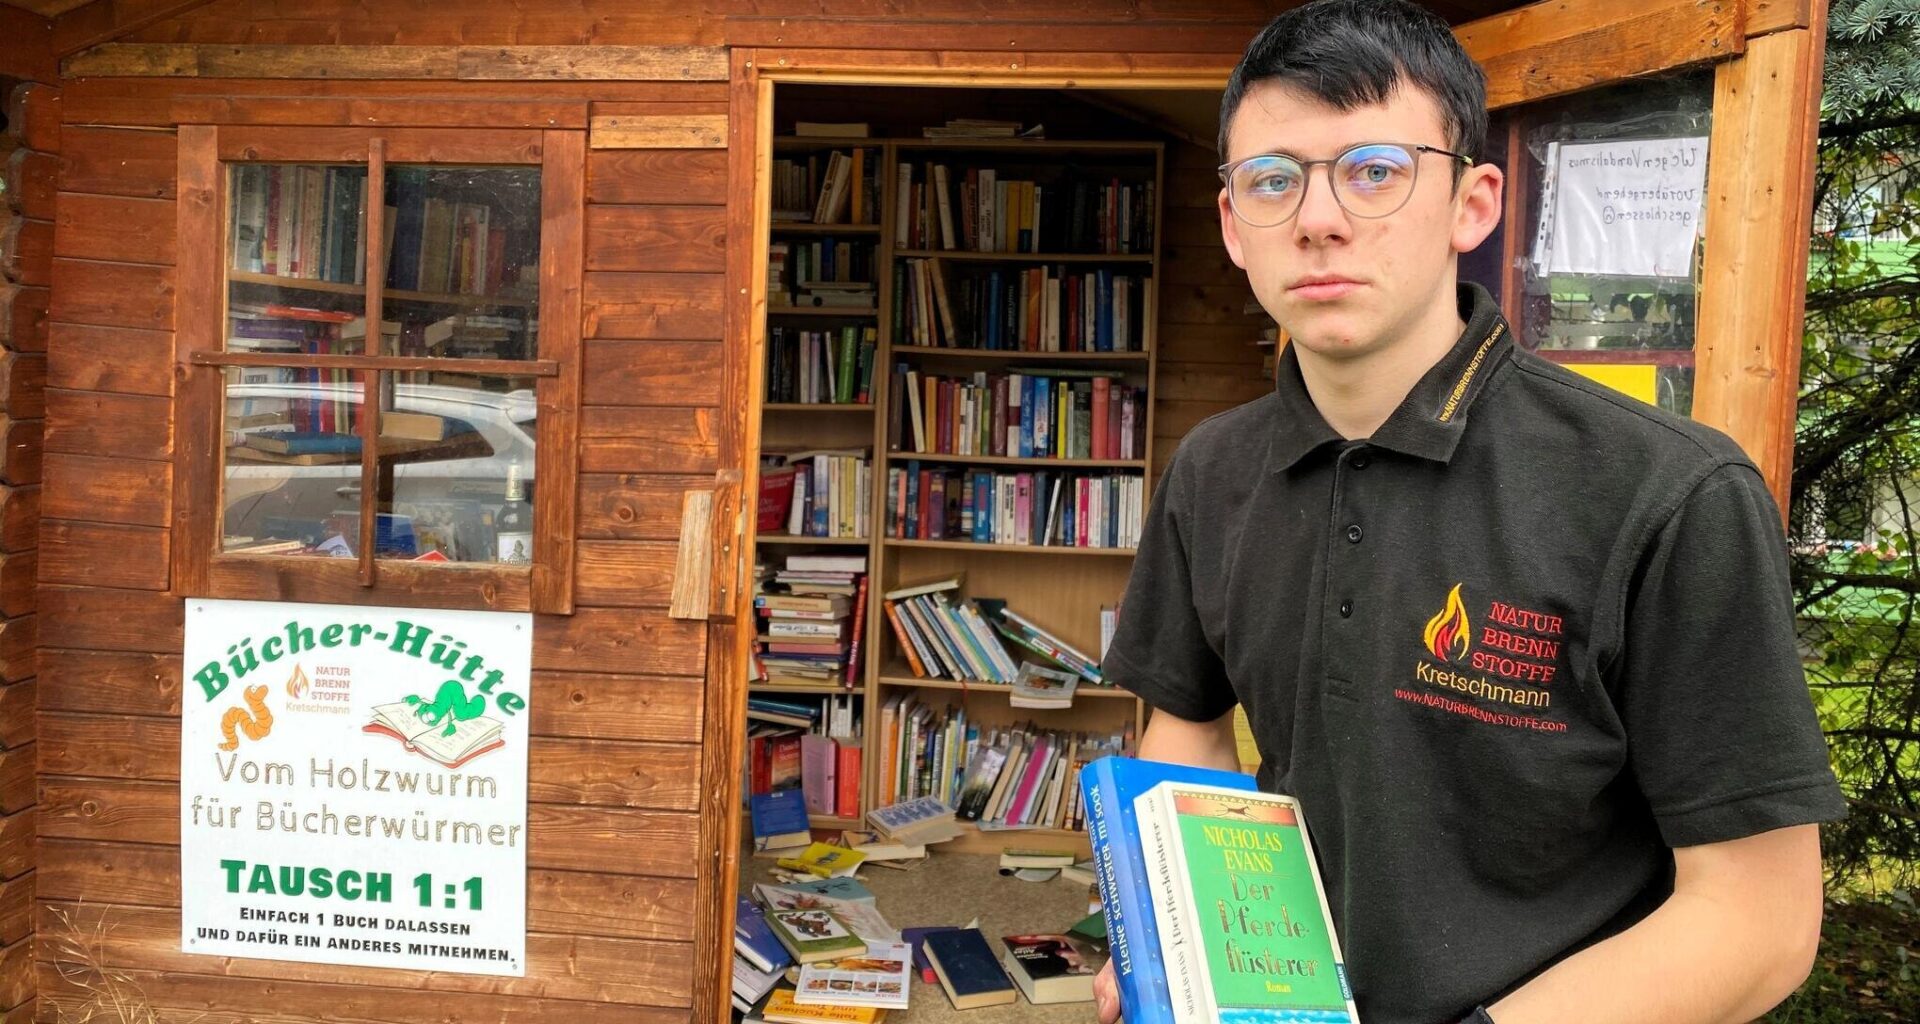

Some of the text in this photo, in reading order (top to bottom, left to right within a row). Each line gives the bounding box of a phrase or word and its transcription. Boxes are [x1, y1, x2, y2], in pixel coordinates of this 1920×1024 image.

[1488, 601, 1562, 634] NATUR
[1481, 627, 1560, 660] BRENN
[192, 620, 526, 717] Bücher-Hütte
[315, 666, 351, 676] NATUR
[1416, 661, 1550, 706] Kretschmann
[1472, 652, 1556, 682] STOFFE
[311, 691, 351, 702] STOFFE
[315, 679, 351, 689] BRENN
[285, 702, 351, 714] Kretschmann
[1395, 689, 1567, 732] www.NATURBRENNSTOFFE.com
[215, 752, 497, 799] Vom Holzwurm
[191, 795, 521, 847] für Bücherwürmer
[1203, 825, 1283, 852] NICHOLAS
[1224, 849, 1274, 873] EVANS
[220, 859, 483, 911] TAUSCH 1:1
[1229, 873, 1274, 901] Der
[239, 907, 471, 936] EINFACH 1 BUCH DALASSEN
[197, 926, 516, 962] UND DAFÜR EIN ANDERES MITNEHMEN.
[1225, 938, 1318, 977] flüsterer
[1265, 980, 1293, 994] Roman
[1337, 966, 1351, 999] GOLDMANN
